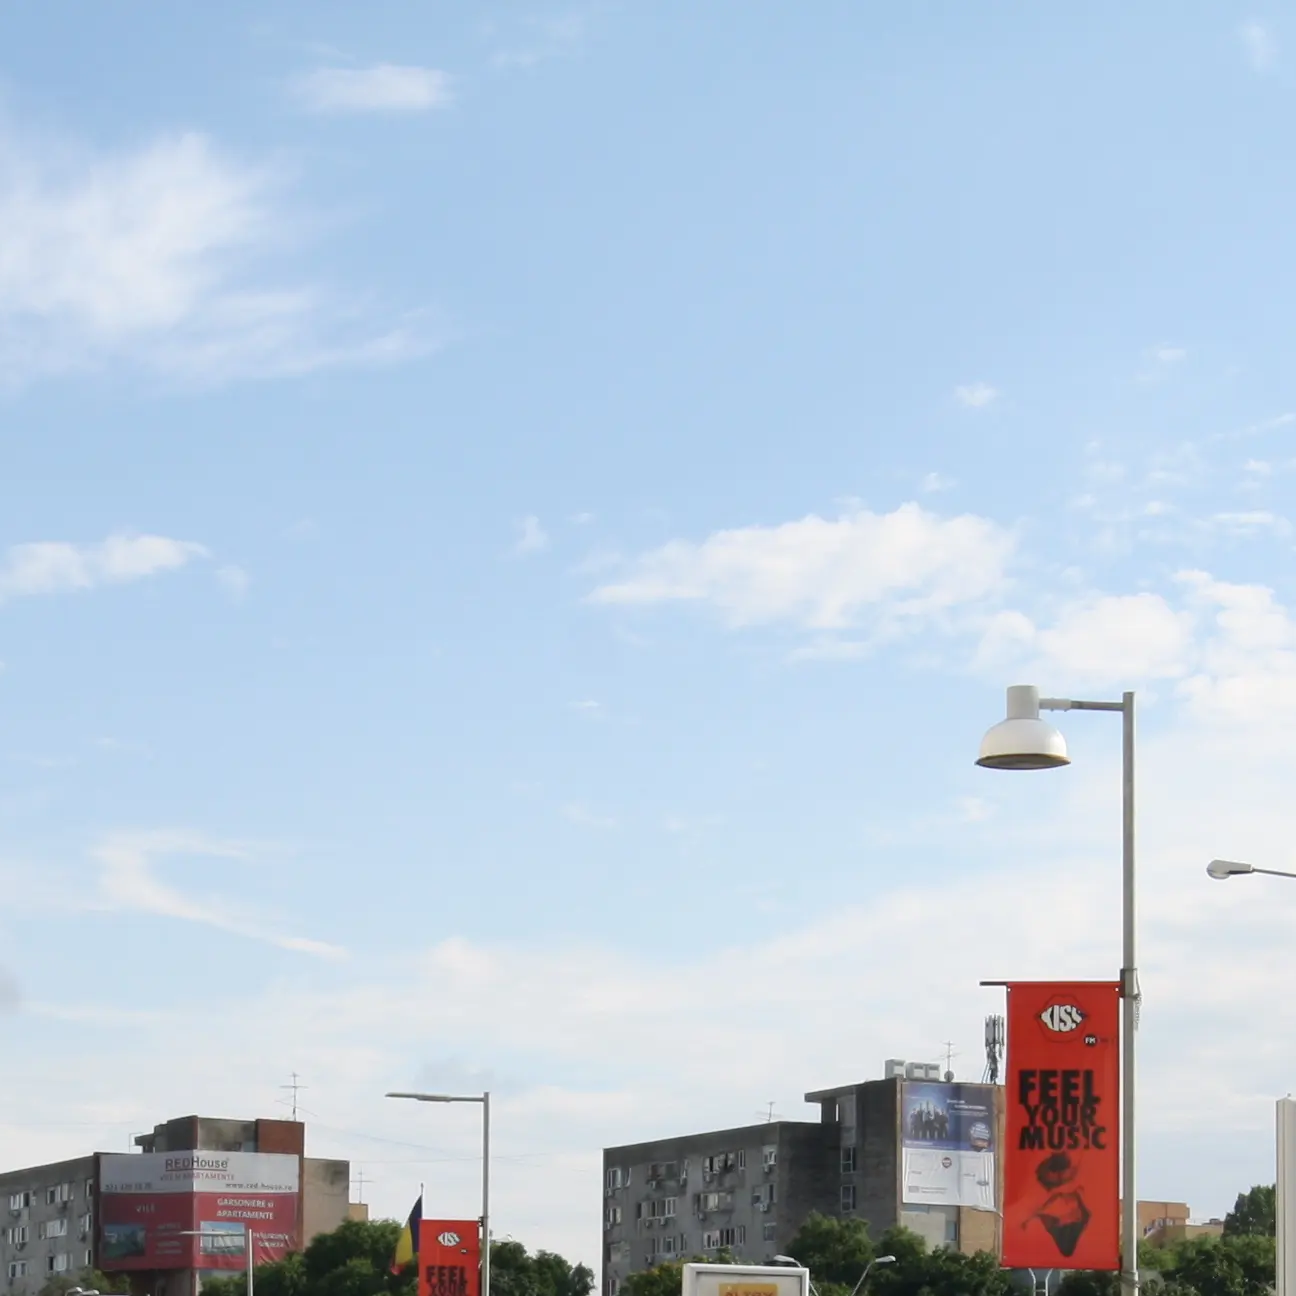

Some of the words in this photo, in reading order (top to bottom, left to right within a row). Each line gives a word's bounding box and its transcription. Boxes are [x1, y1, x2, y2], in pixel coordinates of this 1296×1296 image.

[1040, 1004, 1084, 1032] KISS
[1018, 1069, 1101, 1104] FEEL
[1024, 1100, 1097, 1127] YOUR
[1018, 1124, 1106, 1150] MUSIC
[426, 1265, 467, 1284] FEEL
